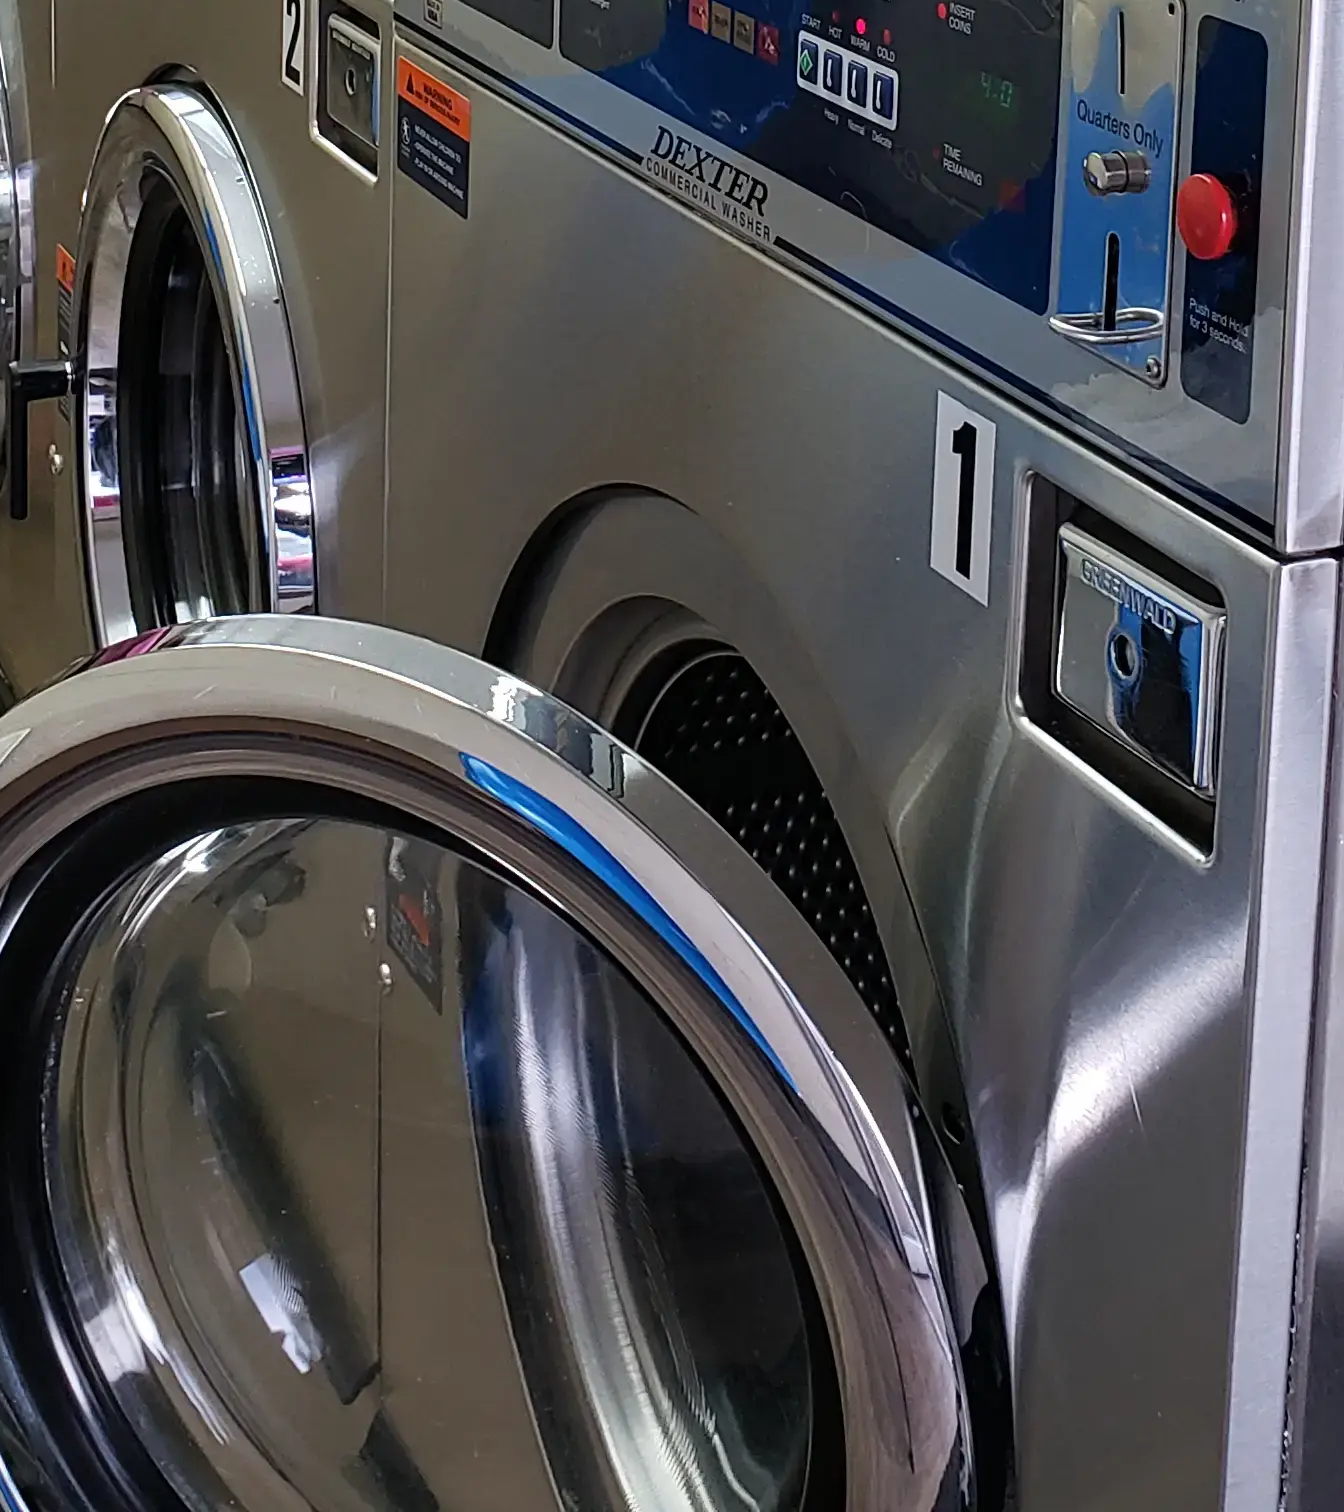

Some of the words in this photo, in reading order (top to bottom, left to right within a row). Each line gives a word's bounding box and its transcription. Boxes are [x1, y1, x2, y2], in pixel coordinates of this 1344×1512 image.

[949, 1, 976, 21] INSERT
[801, 13, 822, 31] START
[948, 16, 972, 36] COINS
[829, 25, 843, 40] HOT
[850, 34, 871, 52] WARM
[876, 45, 896, 63] COLD
[1076, 99, 1130, 139] Quarters
[1133, 123, 1164, 158] Only
[943, 143, 962, 162] TIME
[650, 125, 769, 217] DEXTER
[943, 158, 983, 187] REMAINING
[646, 157, 717, 211] COMMERCIAL
[721, 201, 772, 242] WASHER
[1189, 297, 1210, 319] Push
[1211, 311, 1228, 327] and
[1228, 317, 1249, 338] Hold
[1189, 314, 1201, 330] for
[1201, 320, 1208, 334] 3
[952, 420, 977, 581] 1
[1080, 558, 1177, 635] GREENWALD
